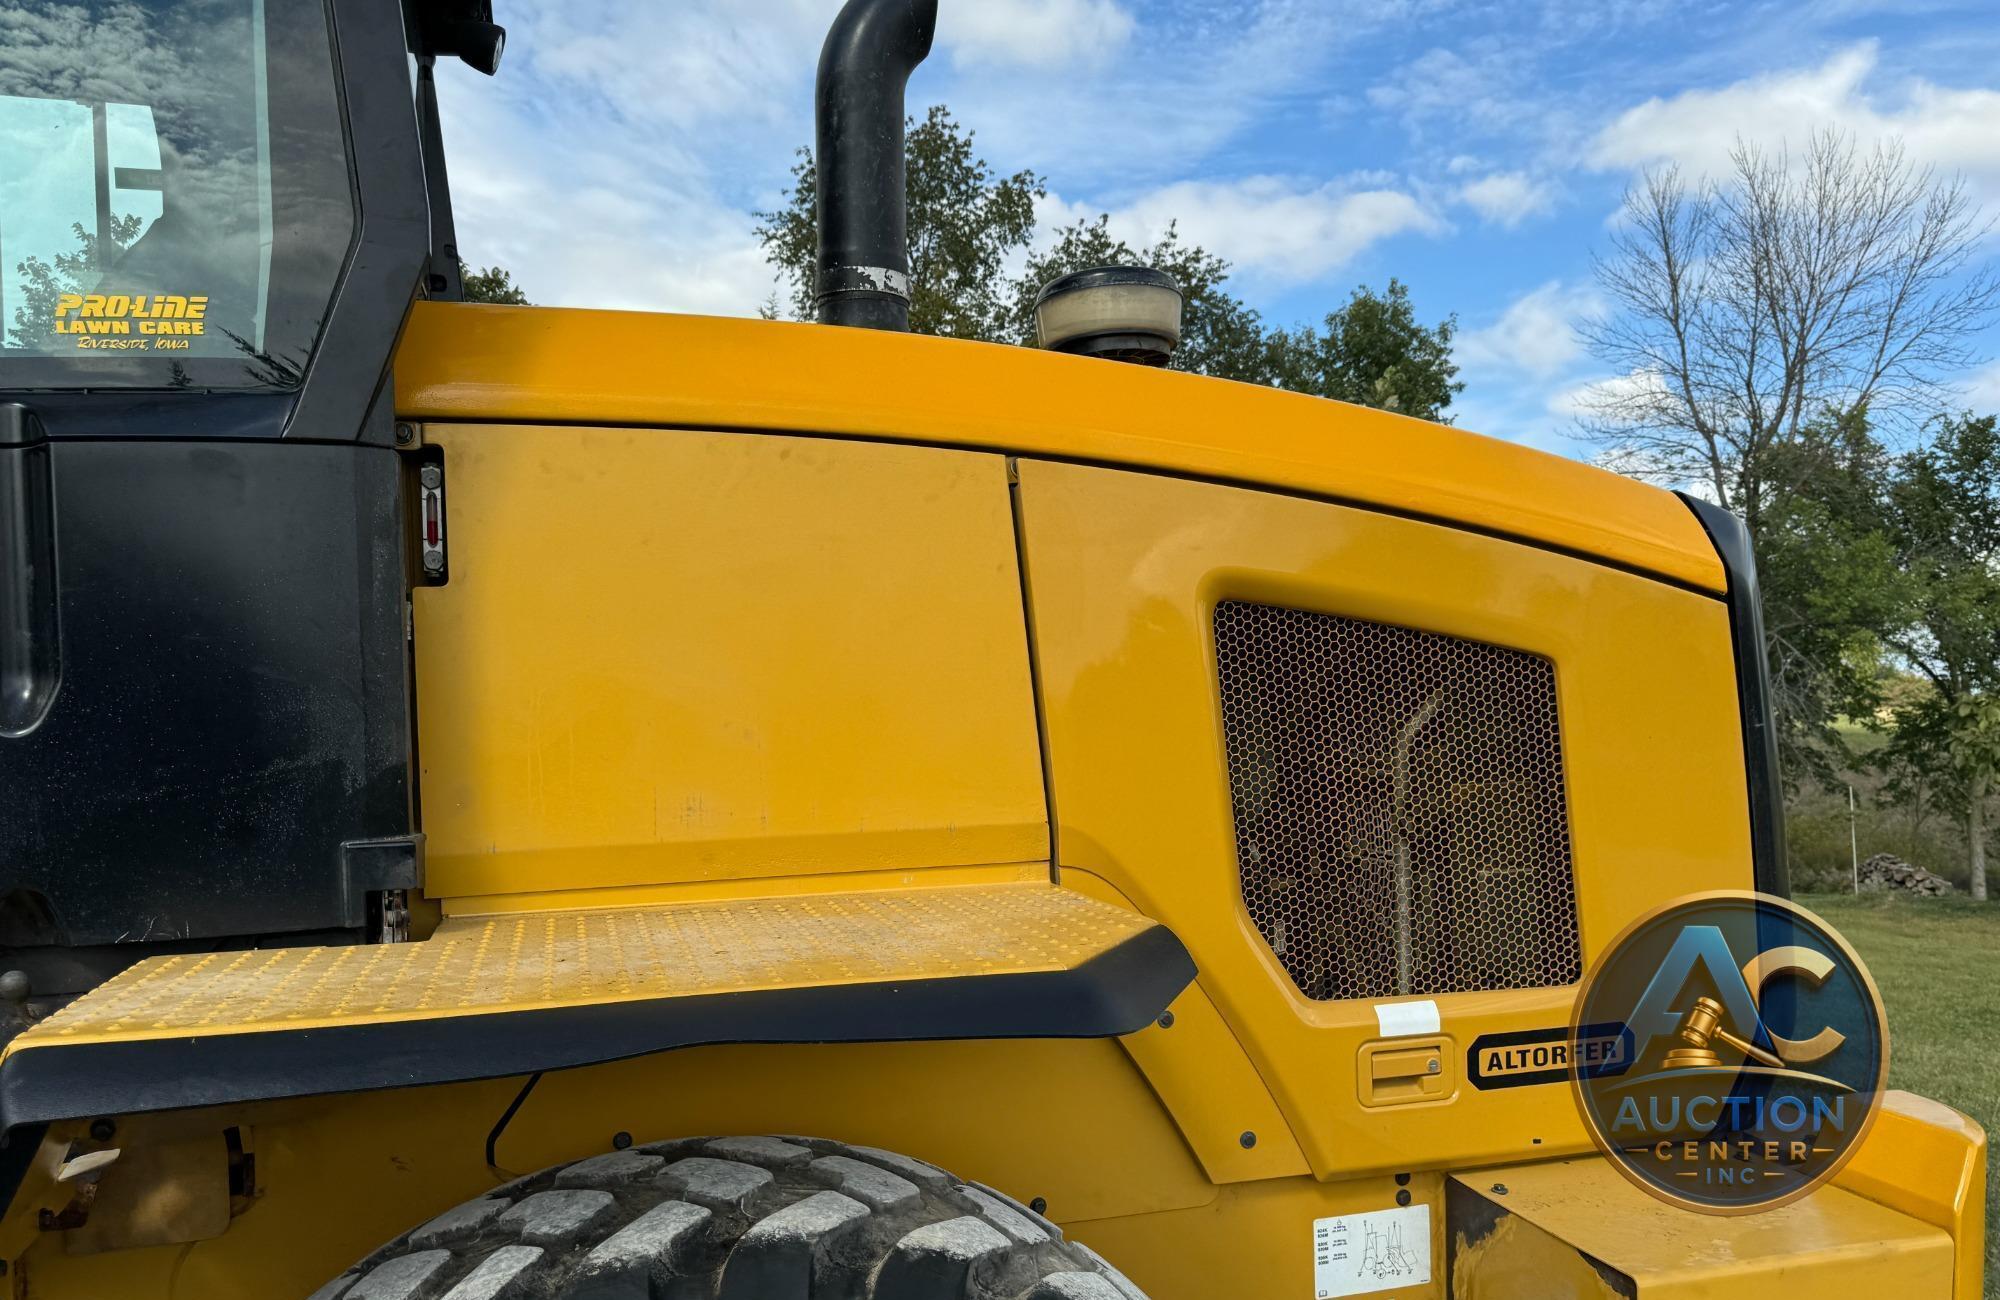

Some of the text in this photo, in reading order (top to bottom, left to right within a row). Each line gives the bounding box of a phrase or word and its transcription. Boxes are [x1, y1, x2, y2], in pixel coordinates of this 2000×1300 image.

[54, 320, 205, 336] LAWN CARE
[154, 337, 190, 350] IOWA
[1486, 1040, 1617, 1072] ALTORFER
